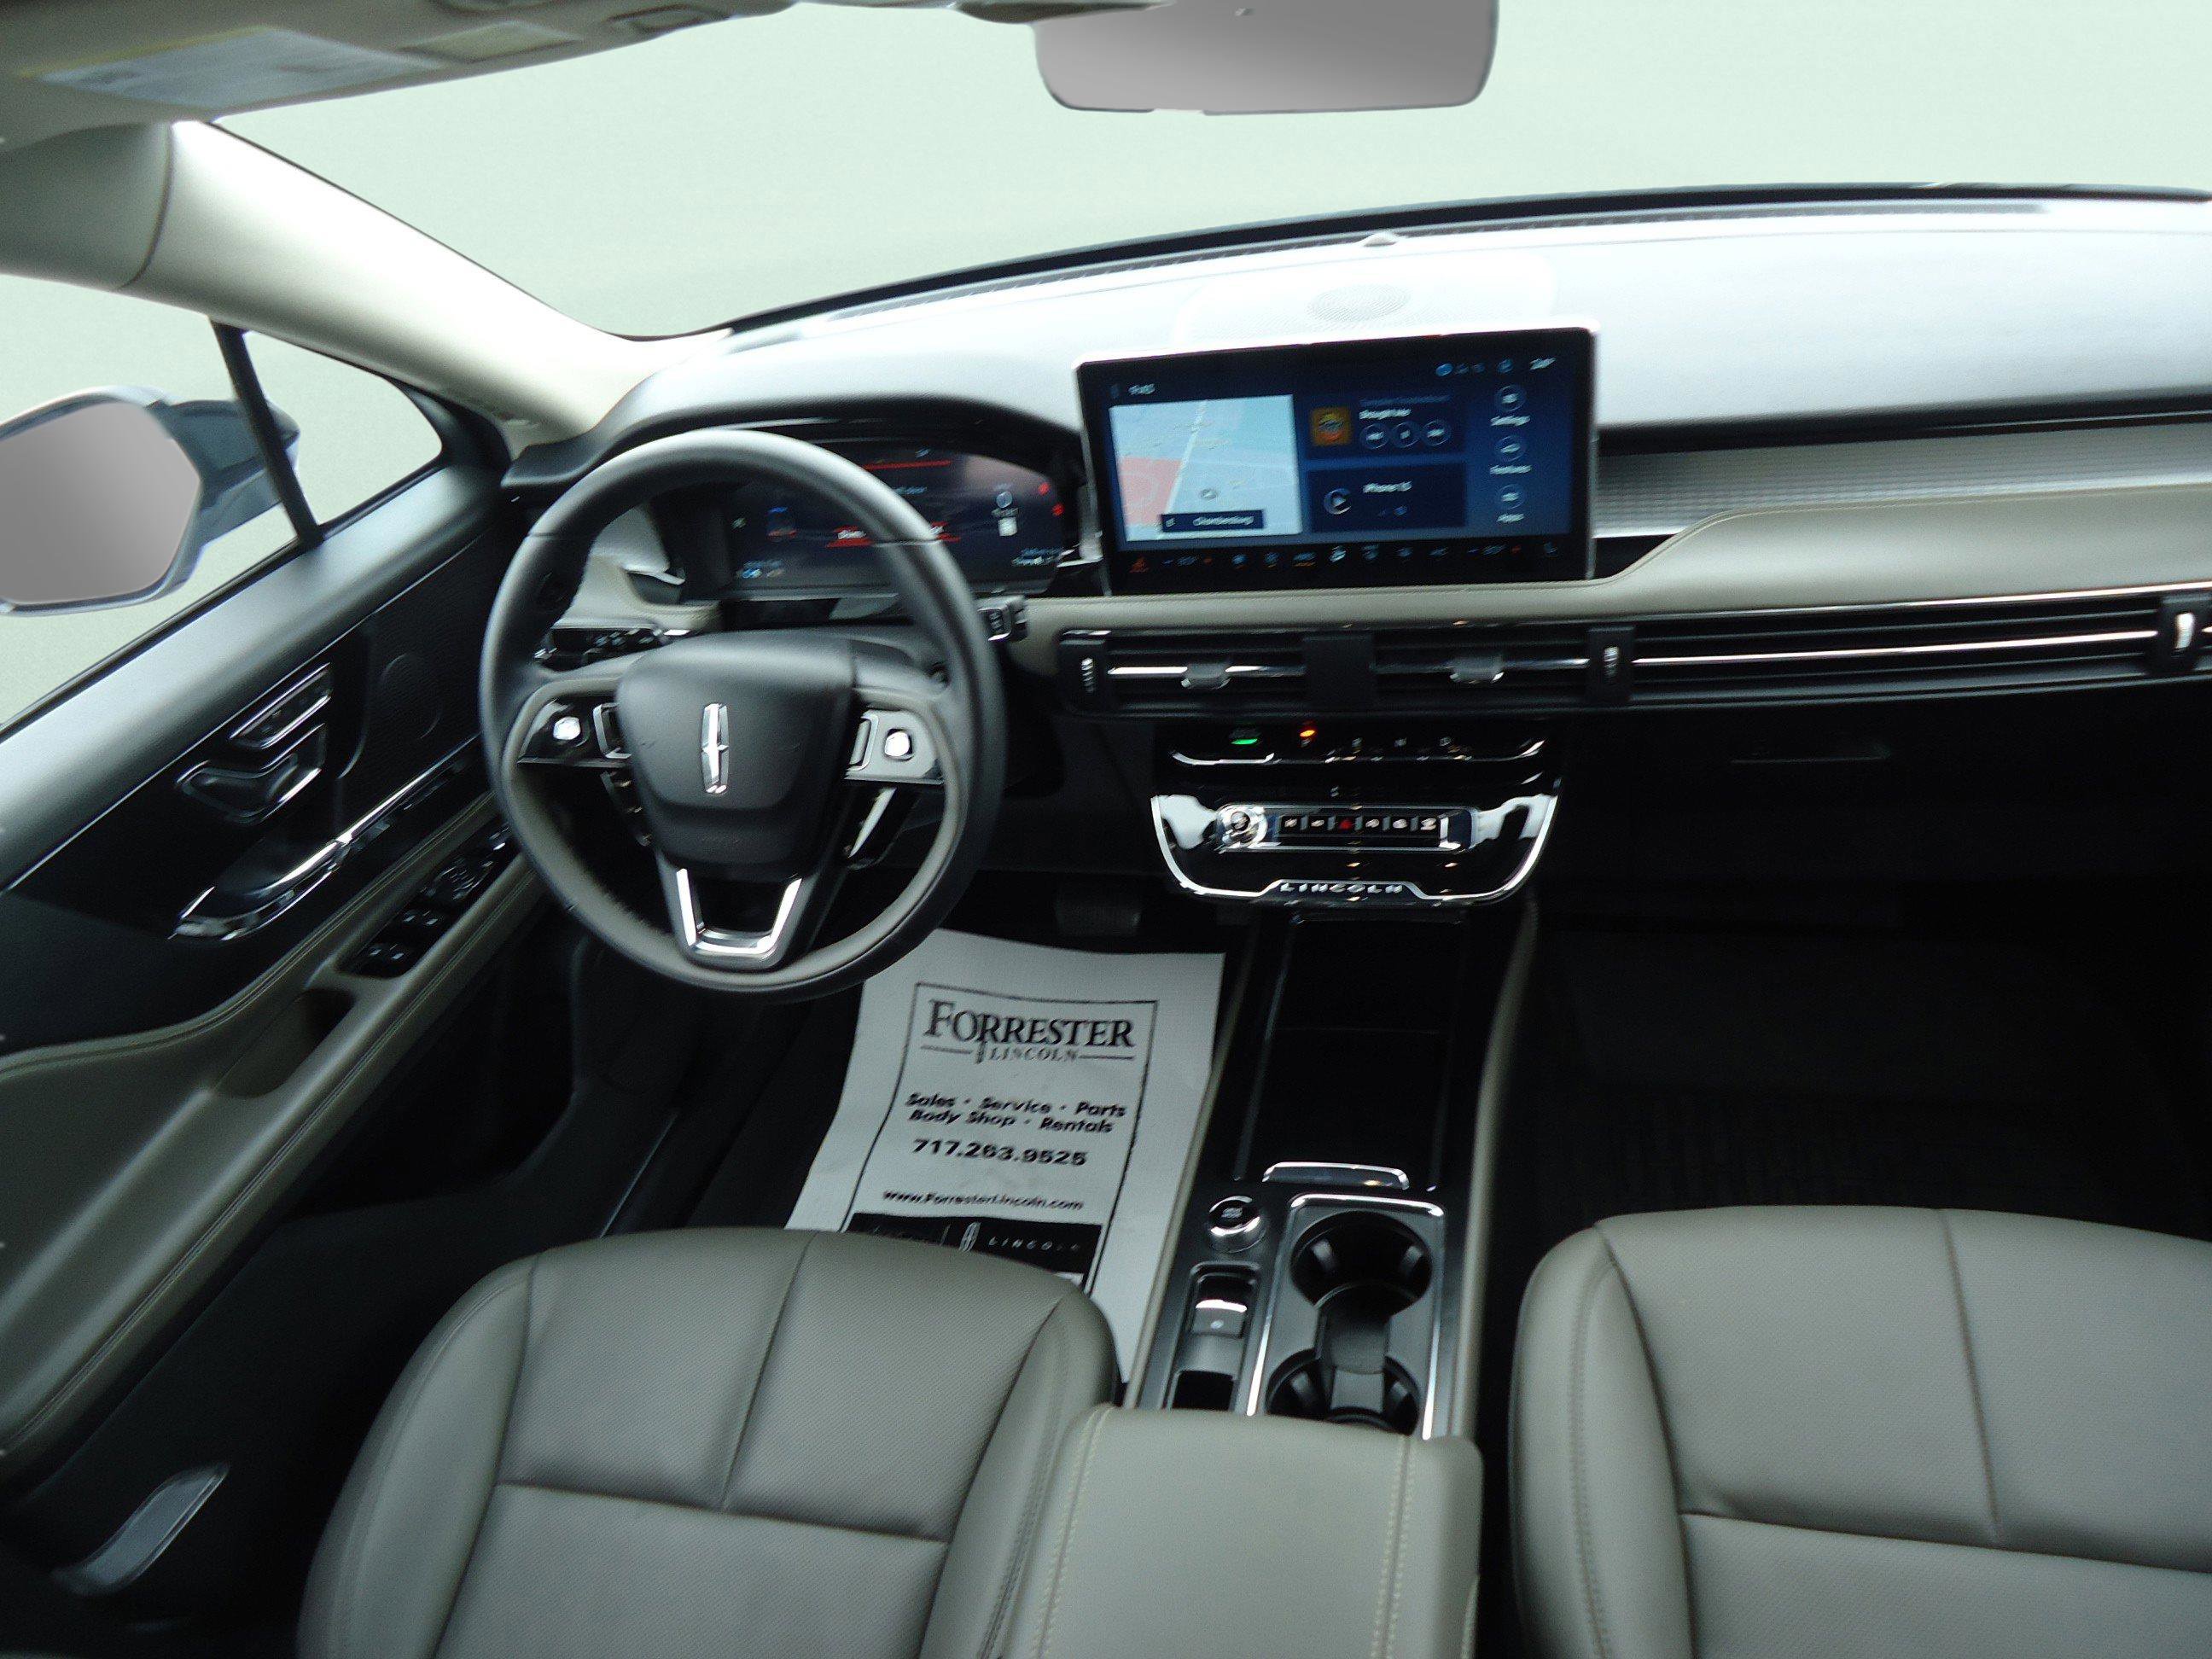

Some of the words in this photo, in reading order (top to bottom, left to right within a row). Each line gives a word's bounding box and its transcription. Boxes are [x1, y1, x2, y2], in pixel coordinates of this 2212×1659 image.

[1279, 882, 1404, 894] LINCOLN
[923, 998, 1136, 1048] FORRESTER
[987, 1046, 1079, 1062] LINCOLN
[905, 1092, 957, 1107] Sales
[978, 1096, 1053, 1115] Service
[1073, 1101, 1126, 1118] Parts
[908, 1109, 962, 1126] Body
[965, 1110, 1017, 1129] Shop
[1037, 1116, 1114, 1133] Rentals
[911, 1138, 1090, 1167] 717.263.9525
